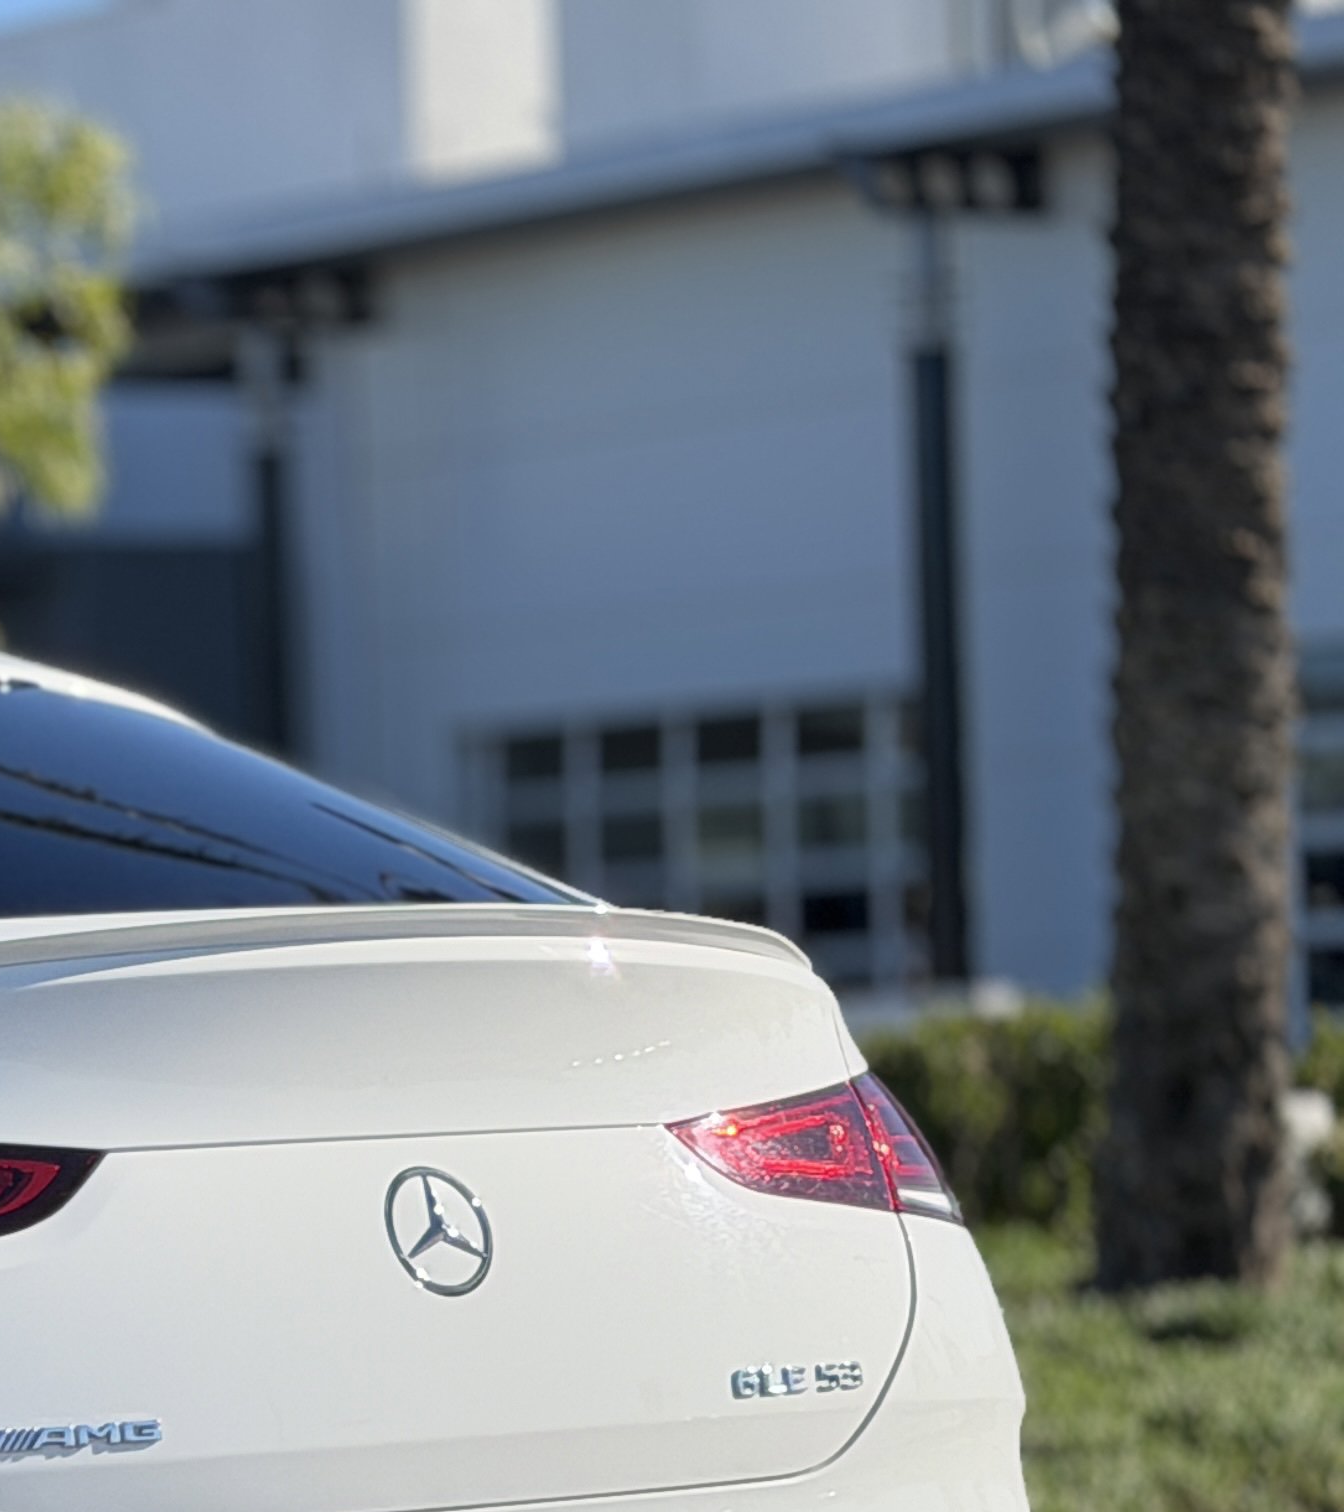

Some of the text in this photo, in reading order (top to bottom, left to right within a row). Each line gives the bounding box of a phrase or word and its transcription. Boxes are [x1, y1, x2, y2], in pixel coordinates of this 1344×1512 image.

[731, 1361, 863, 1400] GLE 53
[34, 1419, 162, 1451] AMG
